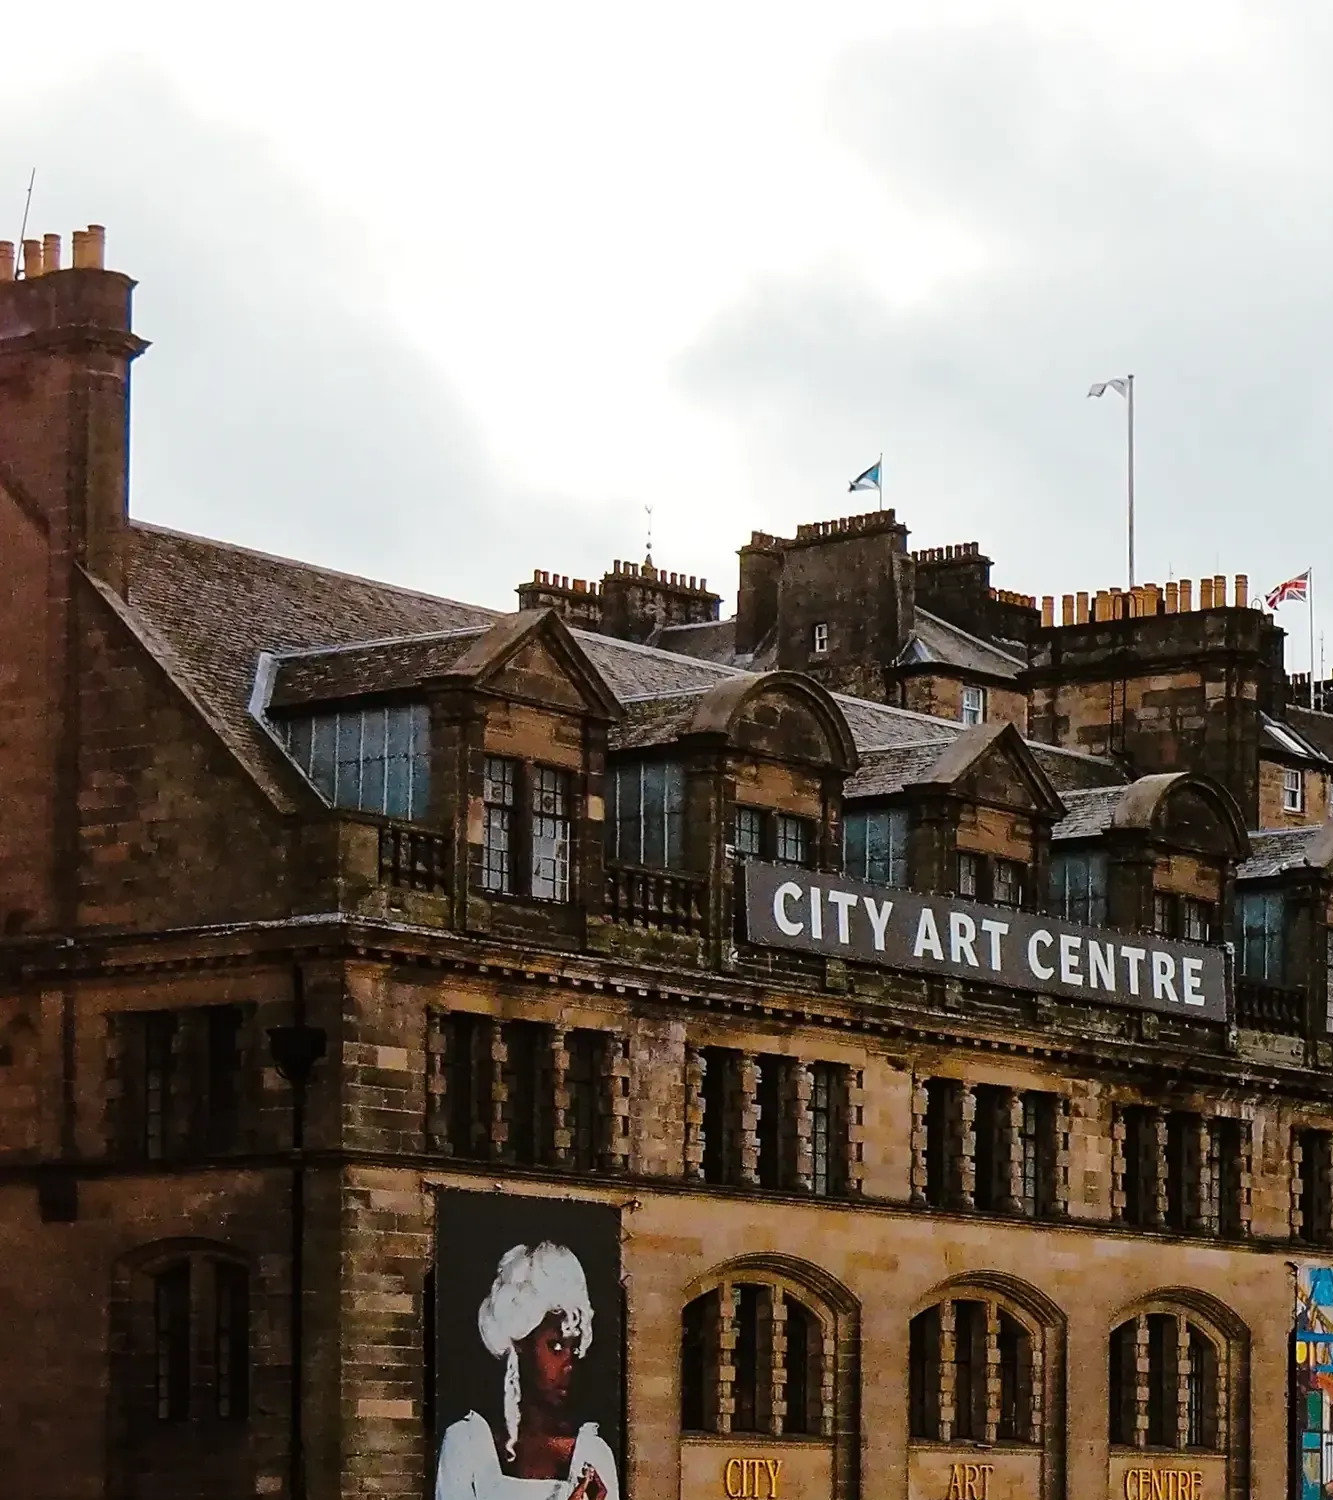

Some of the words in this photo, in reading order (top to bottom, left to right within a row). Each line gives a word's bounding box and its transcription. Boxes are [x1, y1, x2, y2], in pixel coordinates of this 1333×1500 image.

[773, 880, 894, 952] CITY
[913, 907, 1009, 972] ART
[1027, 928, 1206, 1007] CENTRE
[724, 1457, 783, 1499] CITY
